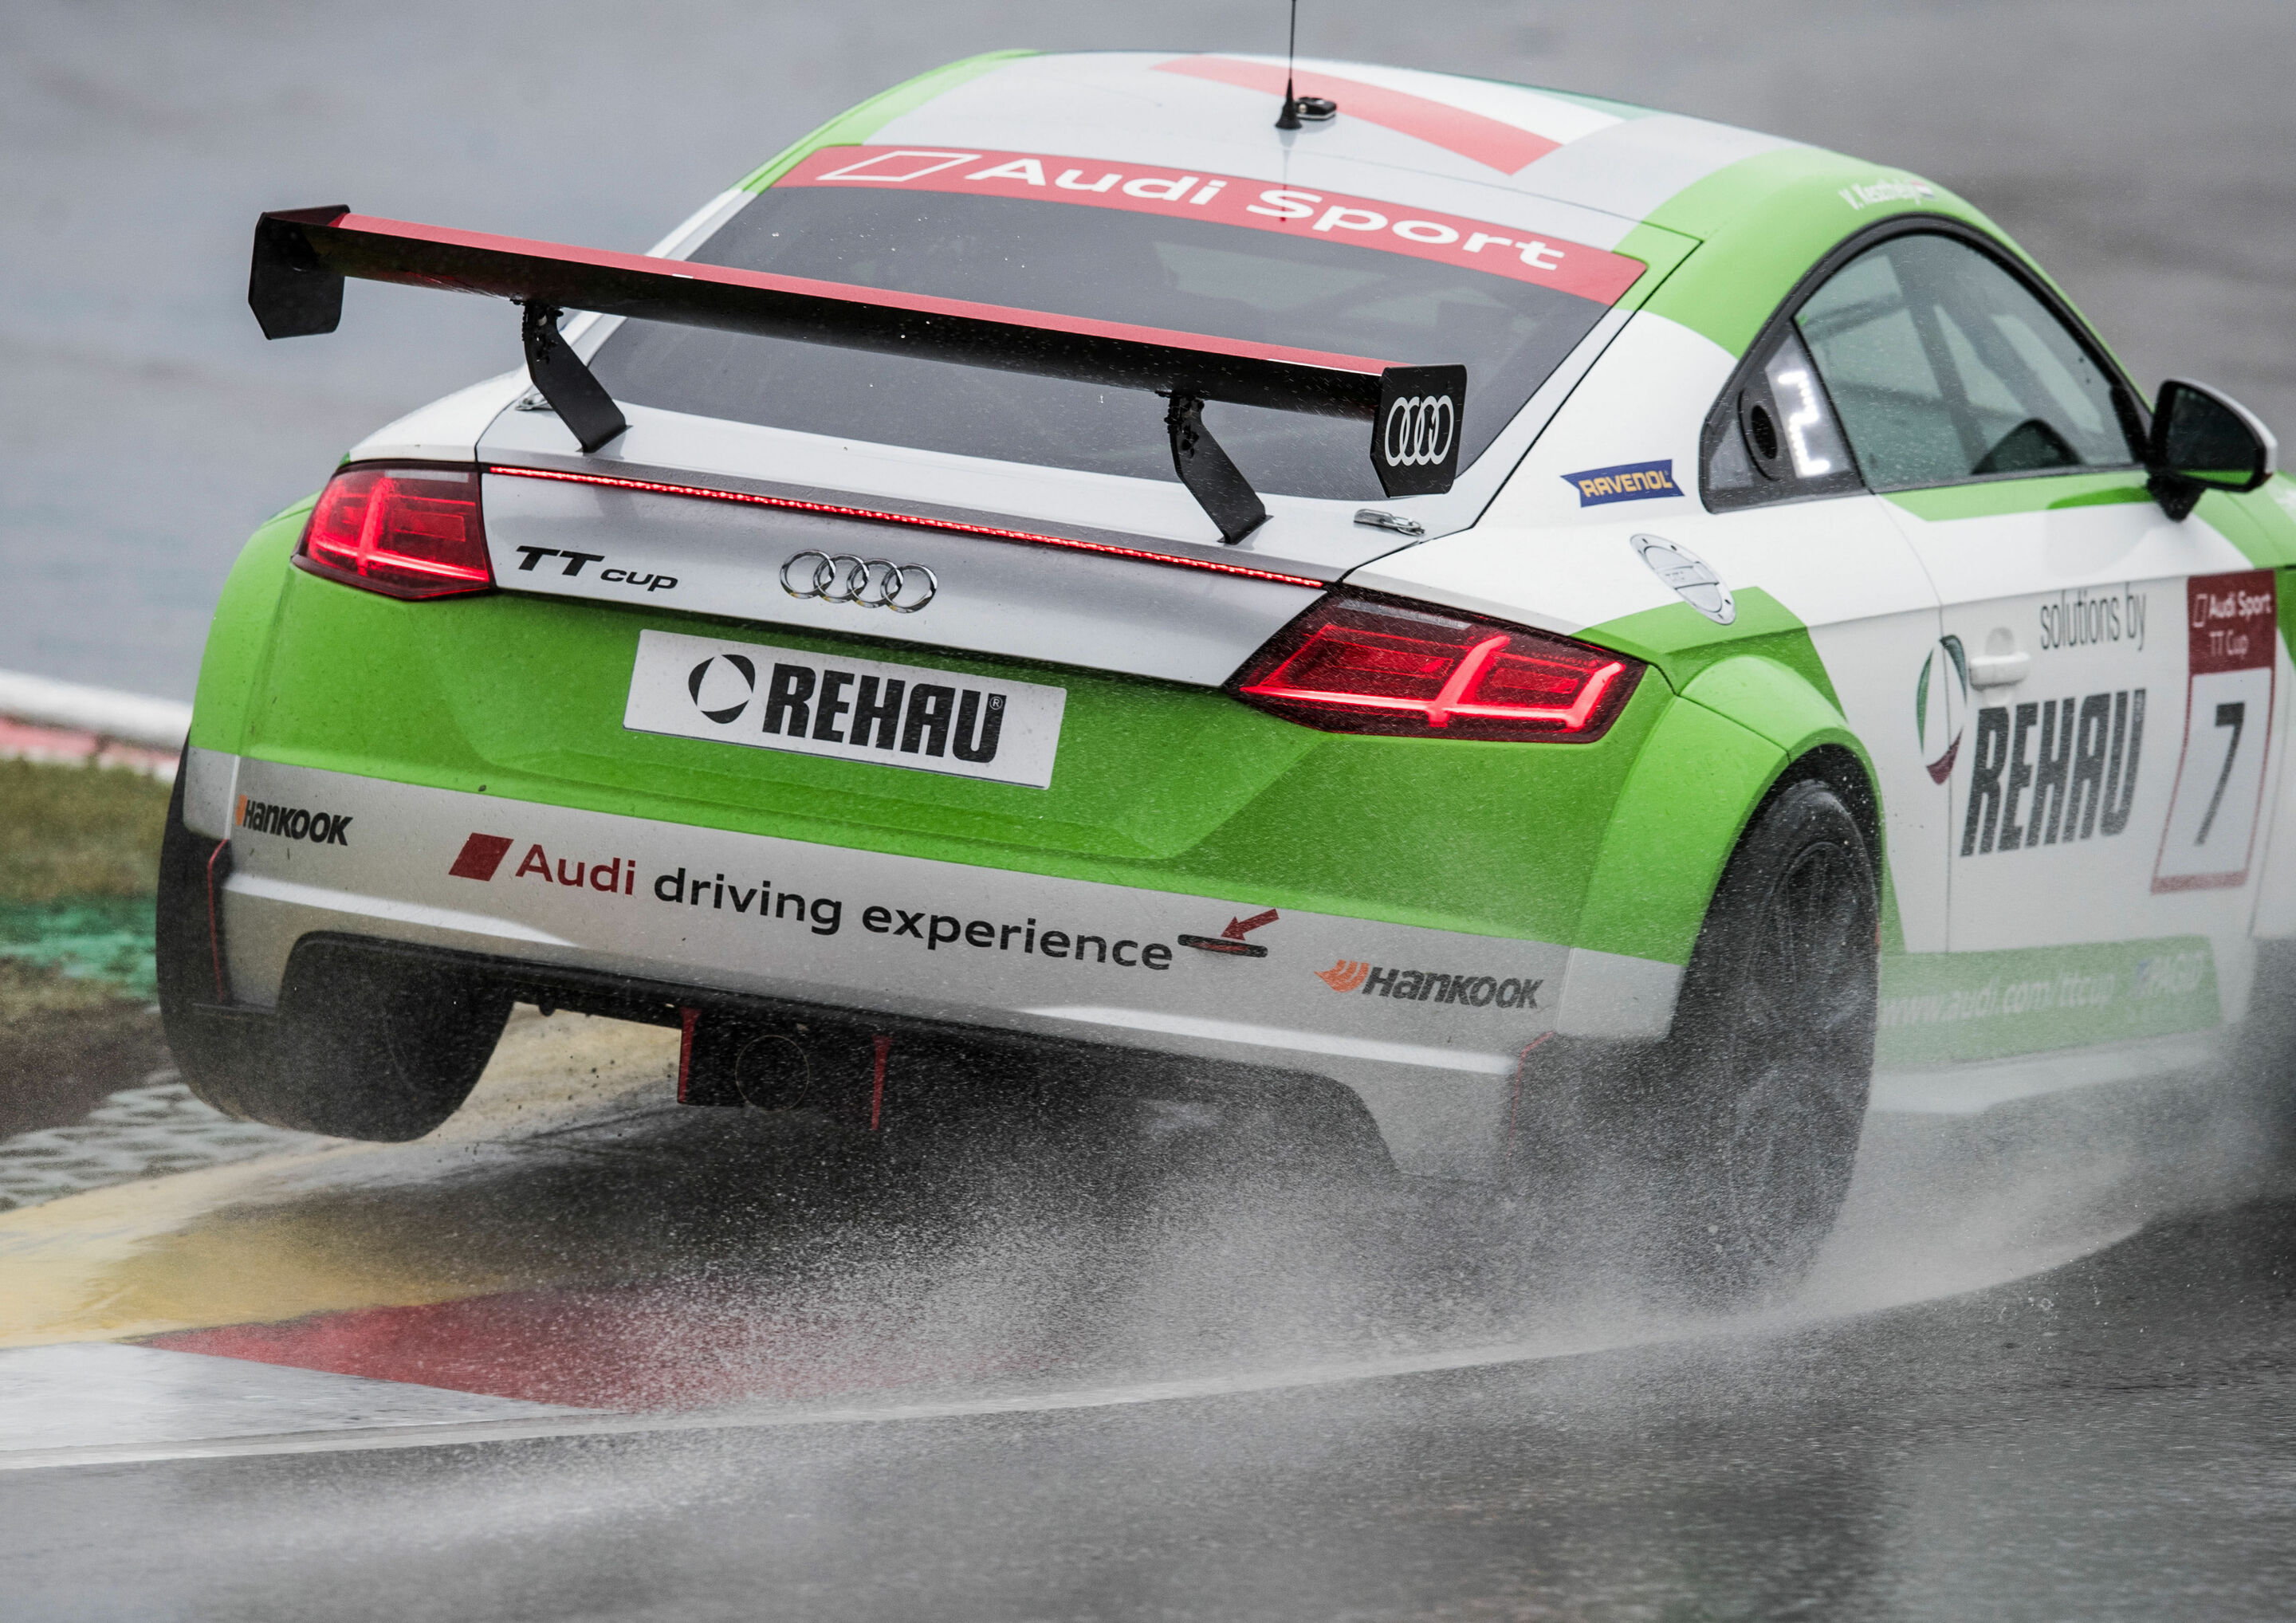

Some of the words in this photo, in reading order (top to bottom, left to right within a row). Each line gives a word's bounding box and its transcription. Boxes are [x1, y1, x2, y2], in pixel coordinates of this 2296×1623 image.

[964, 158, 1229, 206] Audi
[1246, 188, 1566, 271] Sport
[516, 545, 606, 577] TT
[2208, 592, 2235, 619] Audi
[2237, 590, 2272, 623] Sport
[2040, 588, 2121, 650] solutions
[2125, 581, 2147, 652] by
[2209, 631, 2224, 657] TT
[1960, 688, 2147, 859] REHAU
[2194, 701, 2246, 846] 7
[515, 843, 637, 896] Audi
[653, 867, 843, 937] driving
[862, 905, 1175, 971] experience
